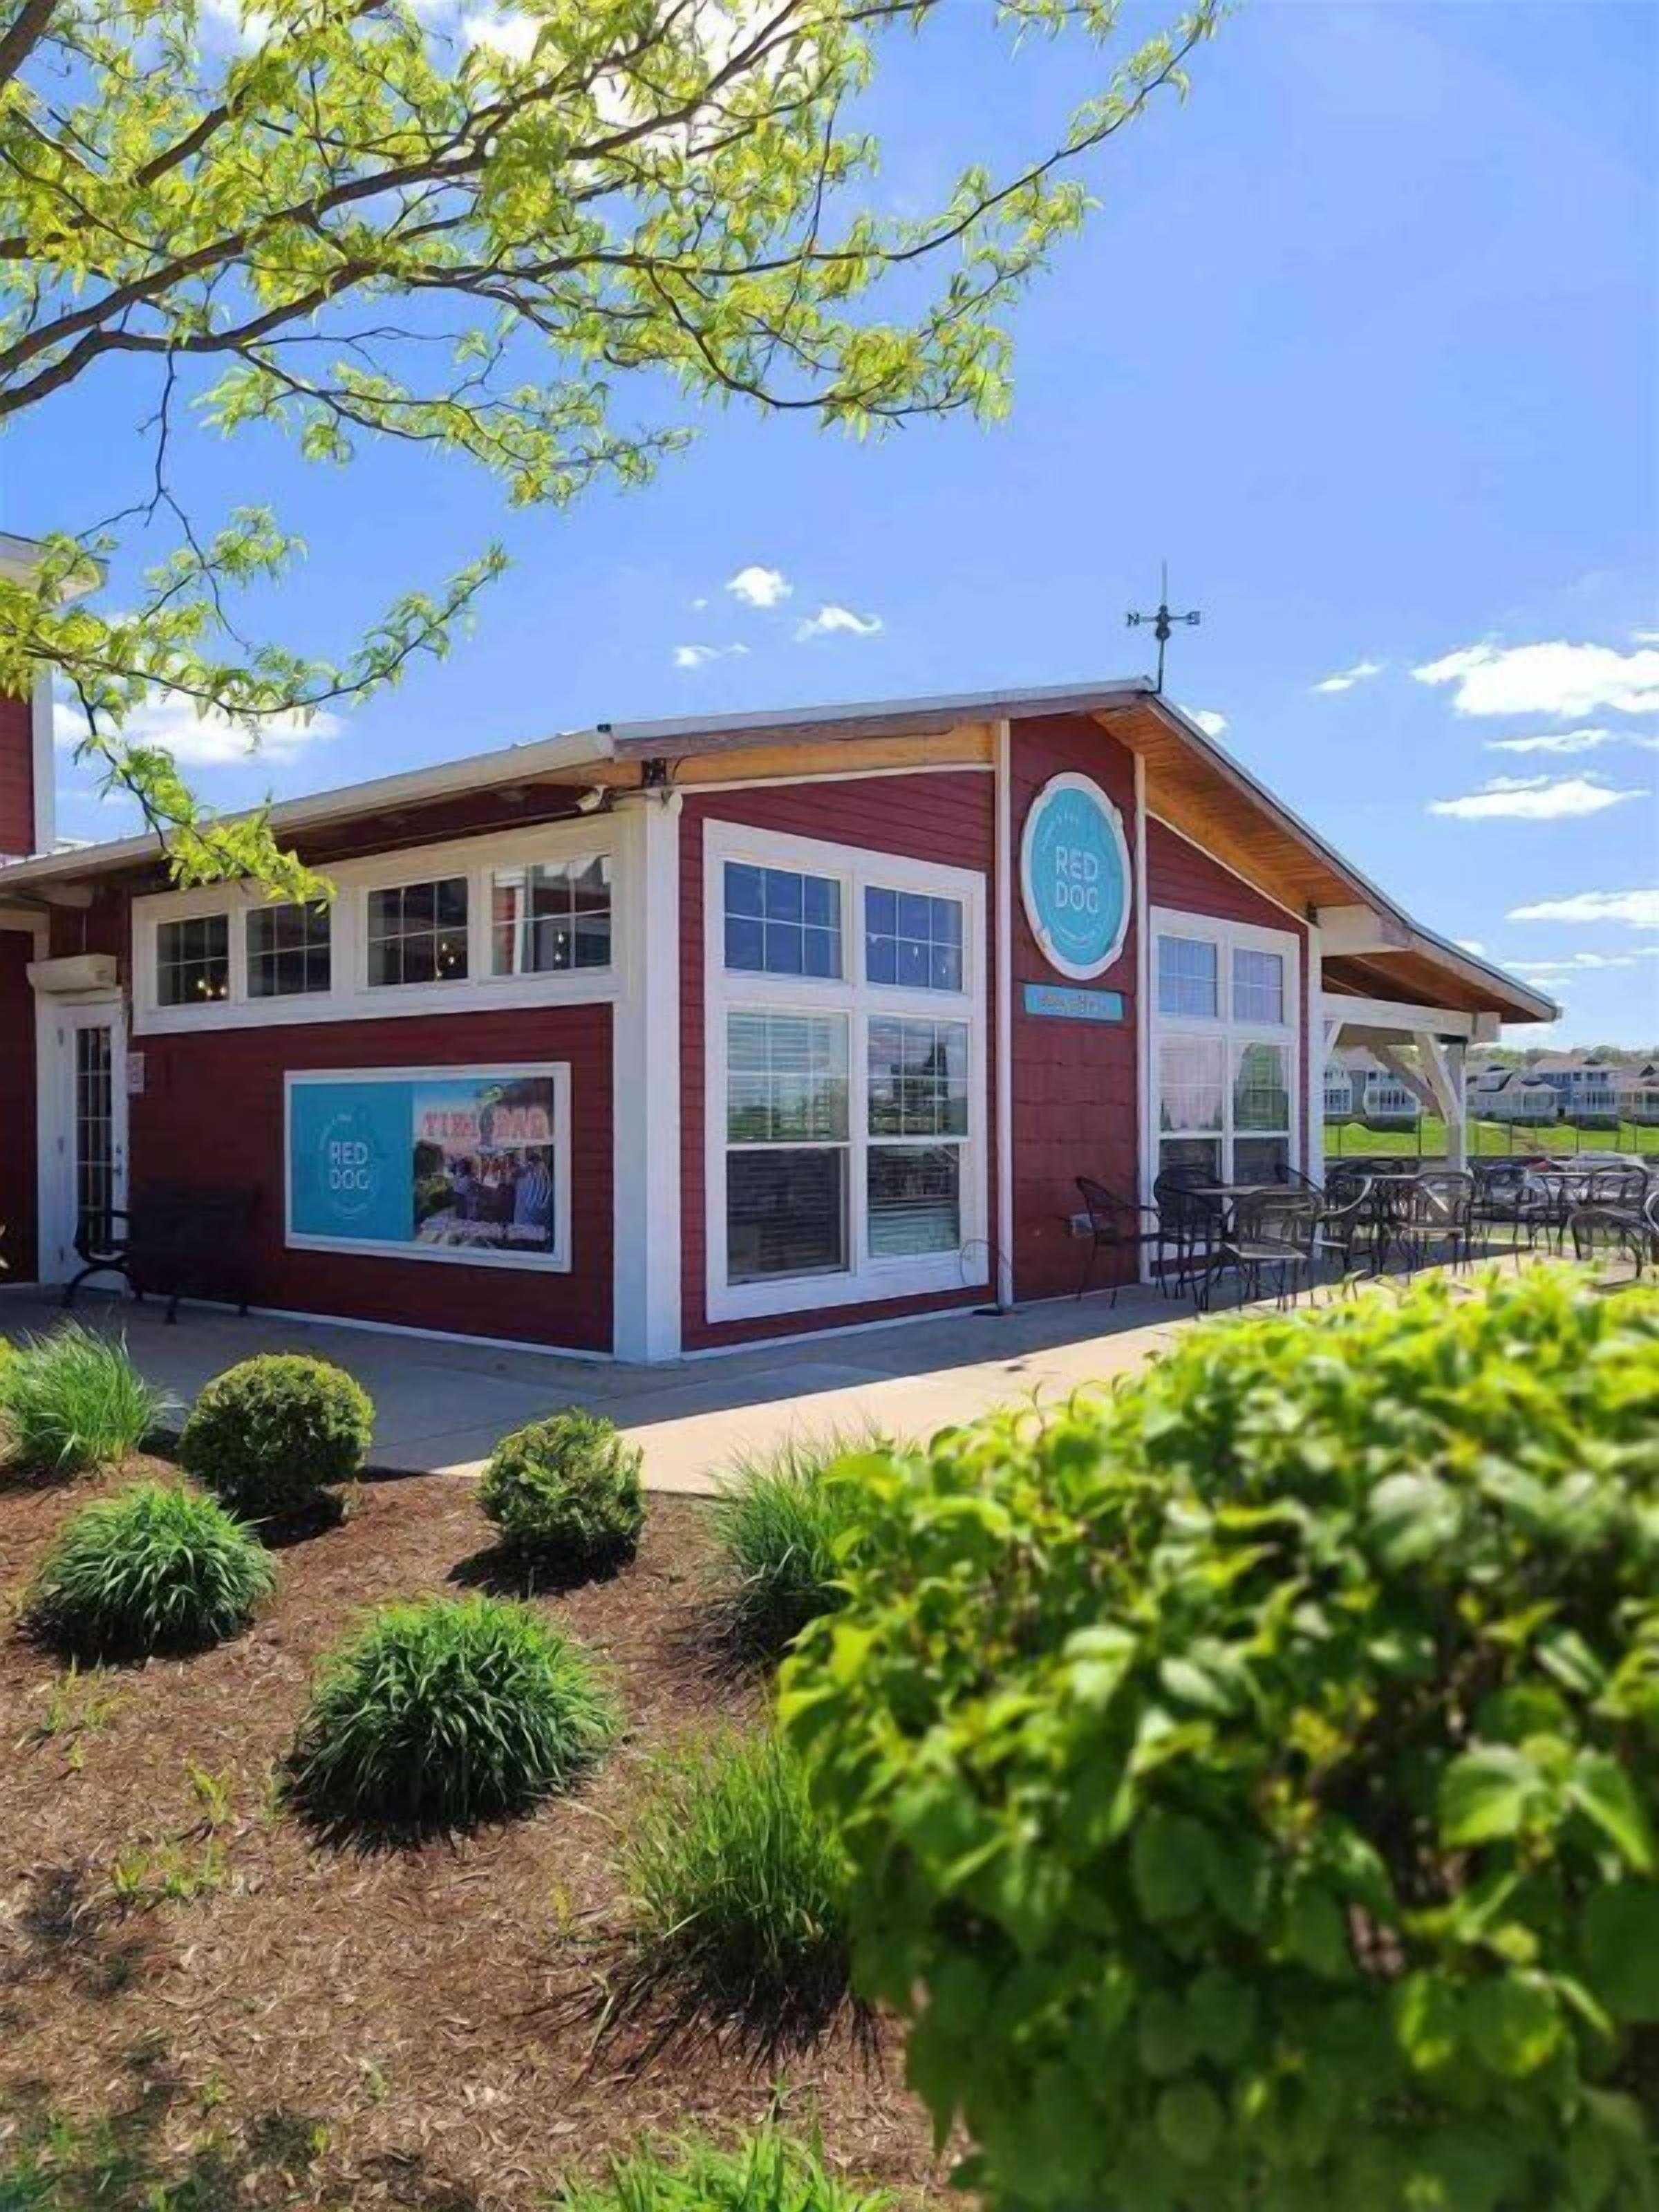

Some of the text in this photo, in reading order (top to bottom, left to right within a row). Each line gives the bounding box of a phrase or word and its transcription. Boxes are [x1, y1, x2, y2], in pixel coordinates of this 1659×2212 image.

[1056, 845, 1098, 881] RED
[1055, 879, 1098, 914] DOG
[330, 1141, 368, 1165] RED
[330, 1169, 370, 1189] DOG
